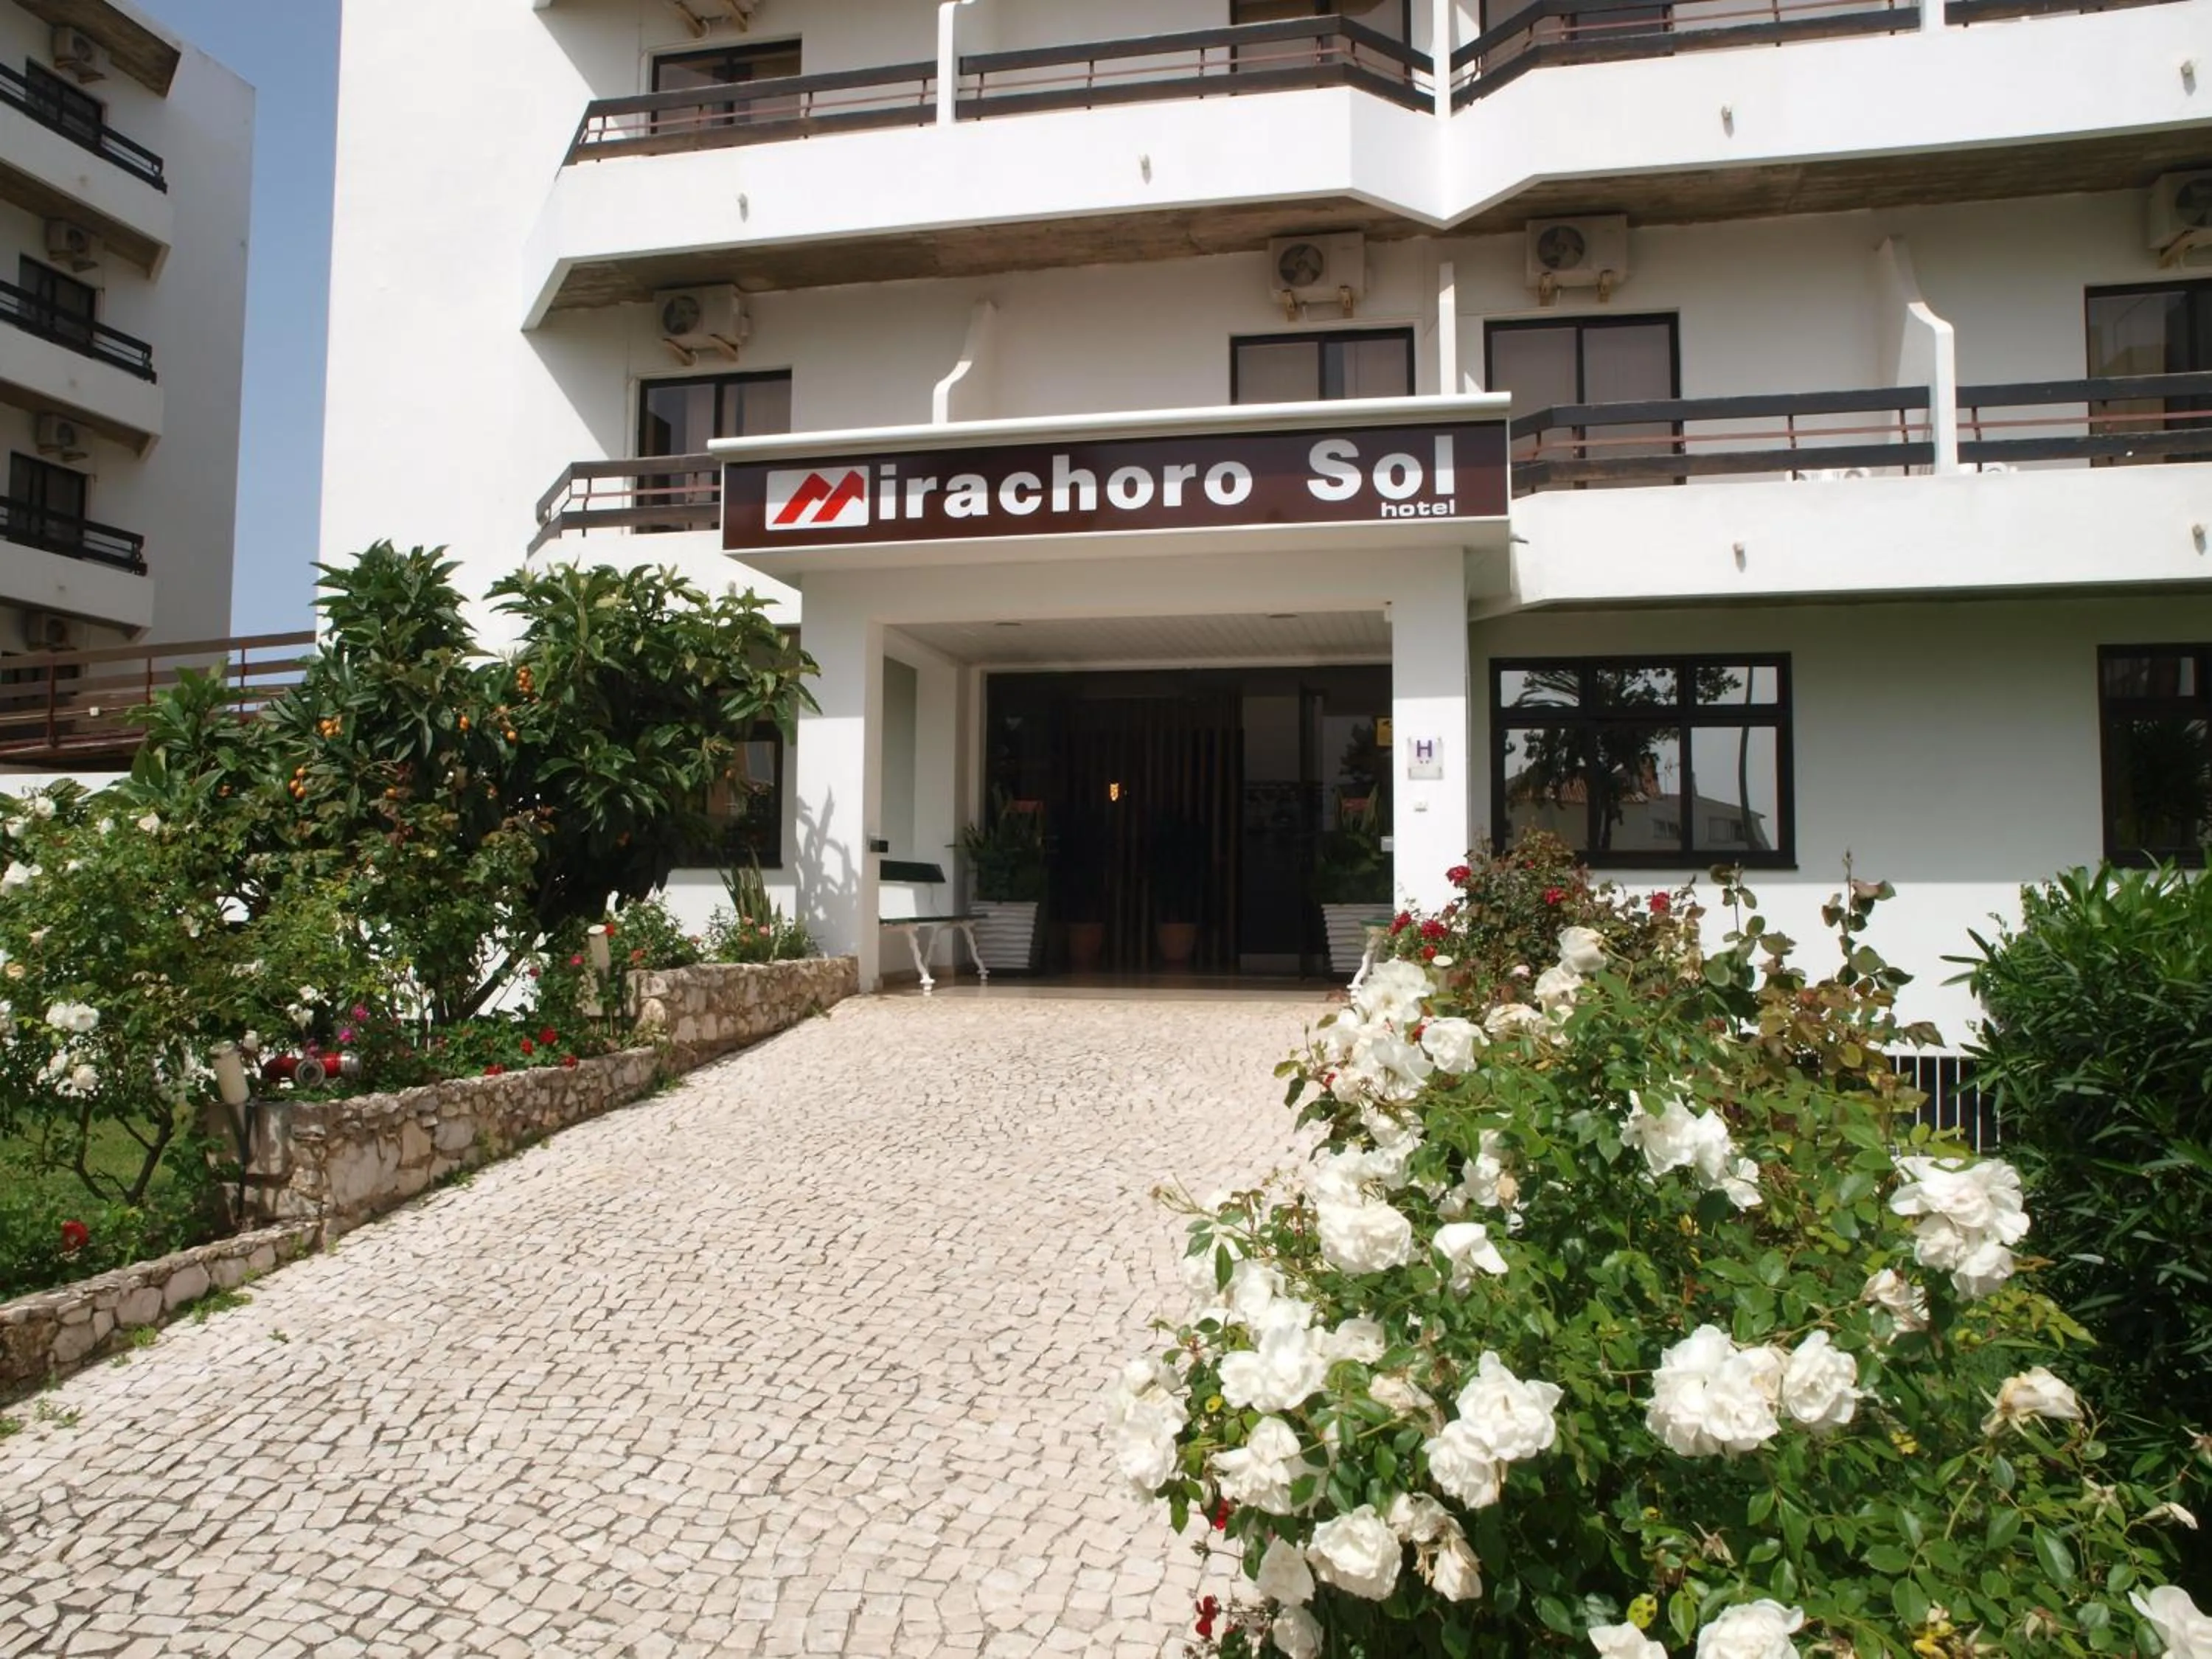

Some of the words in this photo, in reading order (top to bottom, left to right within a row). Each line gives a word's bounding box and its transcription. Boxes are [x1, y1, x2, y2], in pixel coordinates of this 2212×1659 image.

[1307, 435, 1455, 501] Sol
[1381, 498, 1455, 517] hotel
[1416, 740, 1433, 757] H
